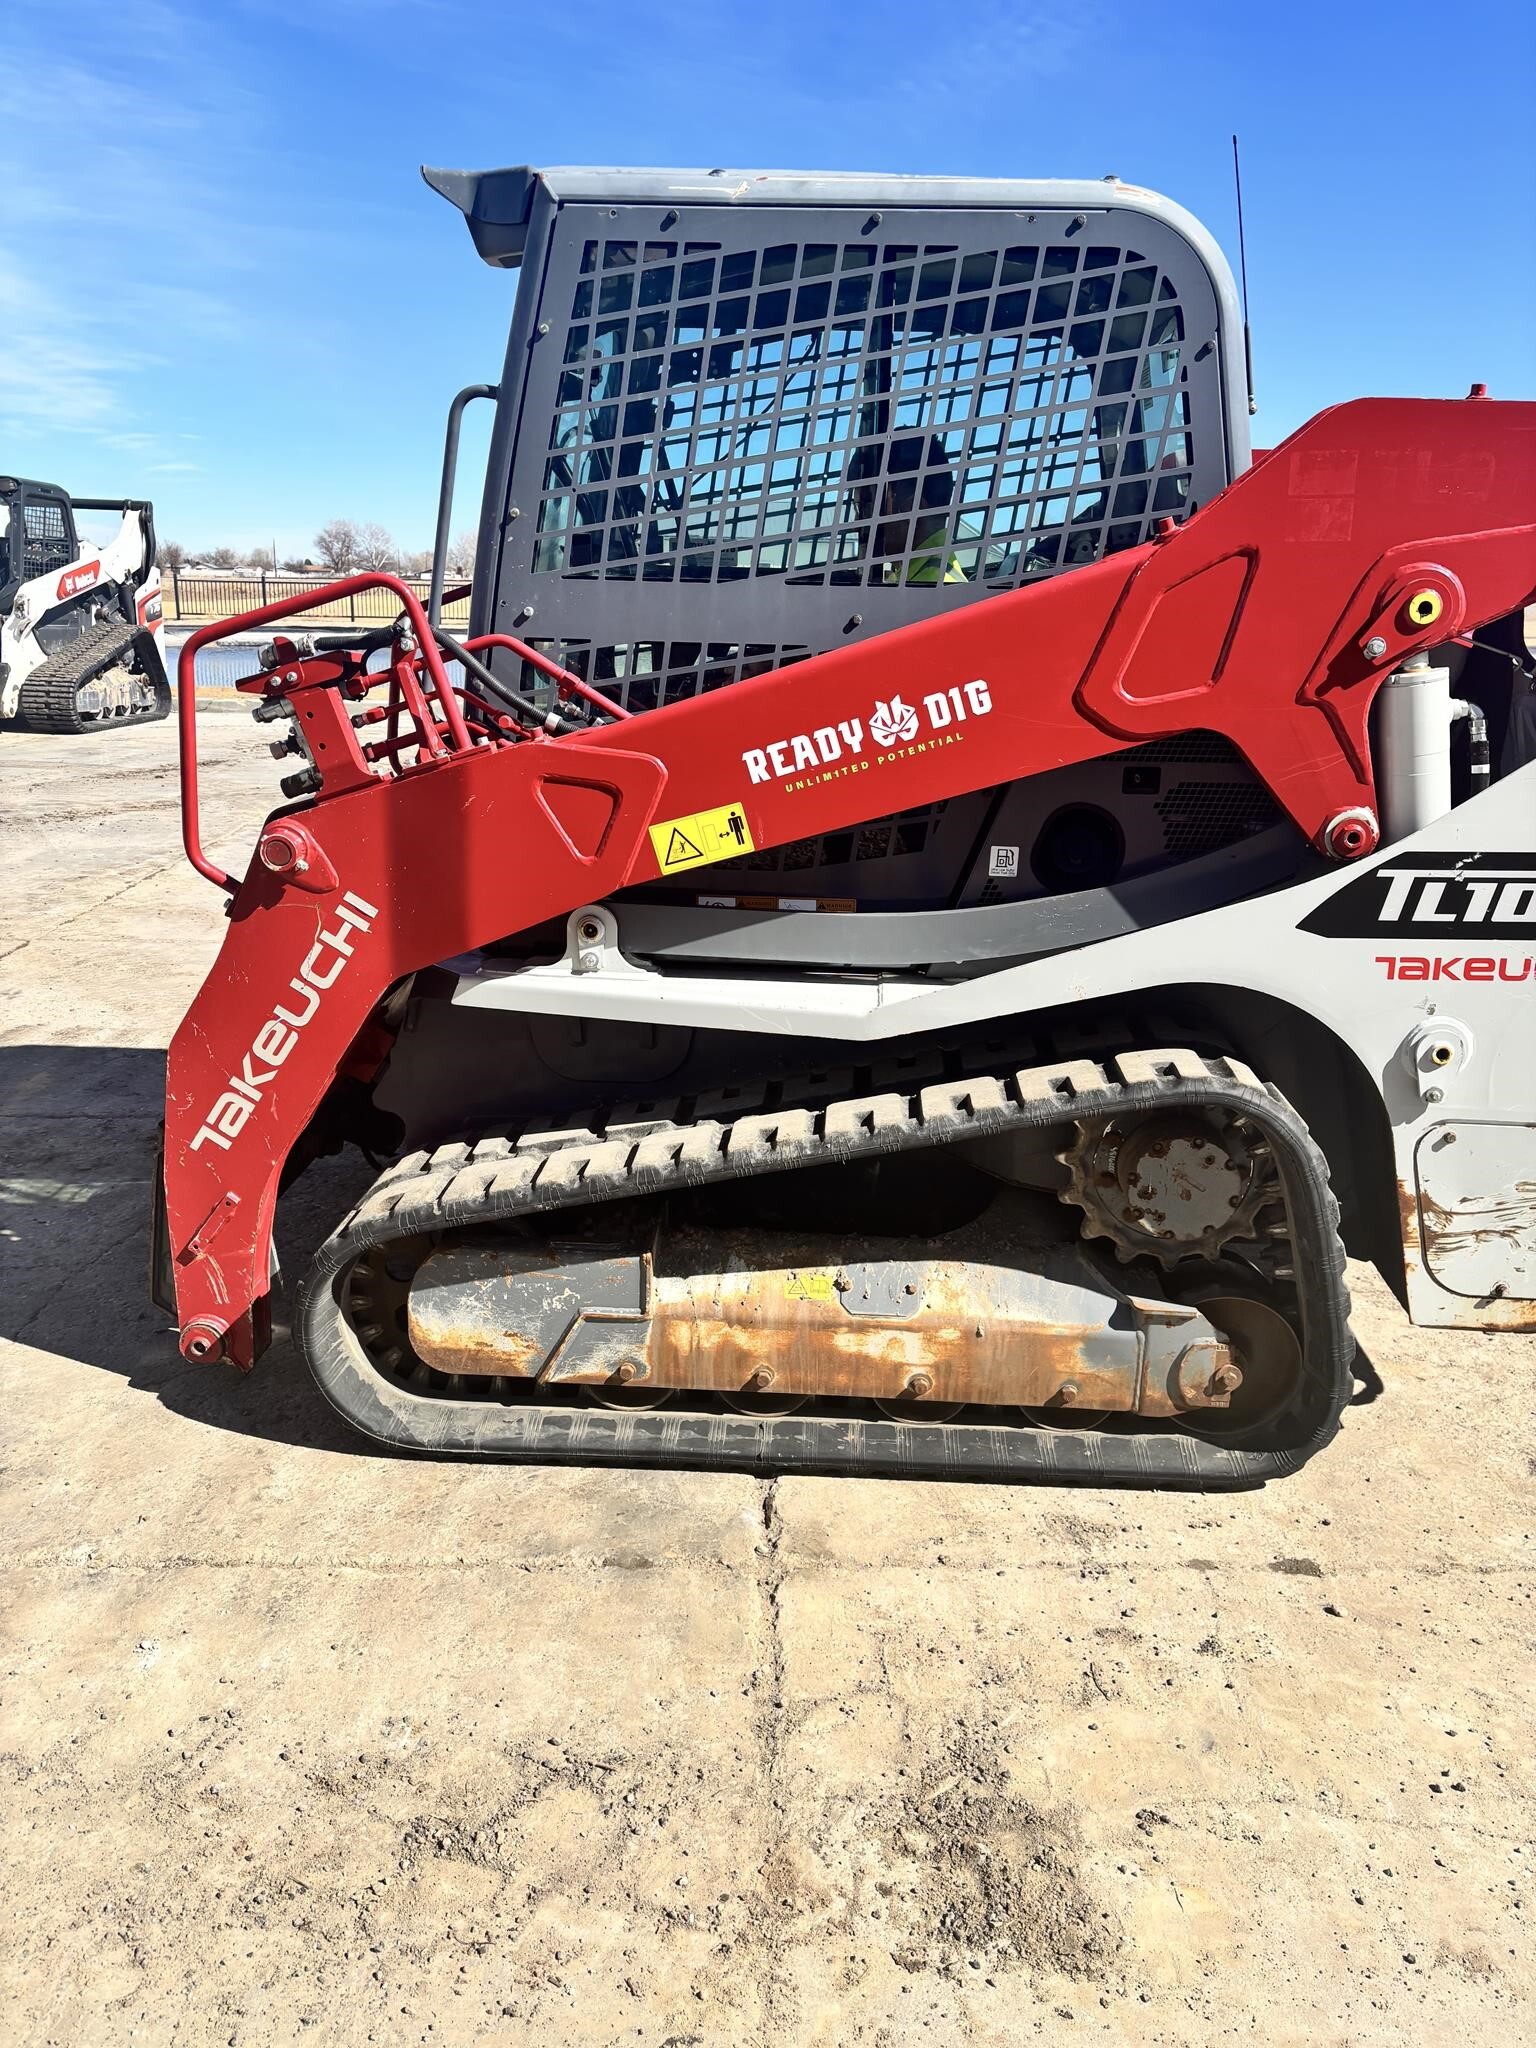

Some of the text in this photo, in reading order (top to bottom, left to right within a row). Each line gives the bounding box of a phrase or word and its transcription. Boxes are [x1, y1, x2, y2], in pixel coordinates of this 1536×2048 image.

[74, 570, 96, 590] Bobcat
[741, 679, 993, 785] READY DIG
[785, 732, 964, 793] UNLIMITED POTENTIAL
[1375, 956, 1536, 982] TAKEU
